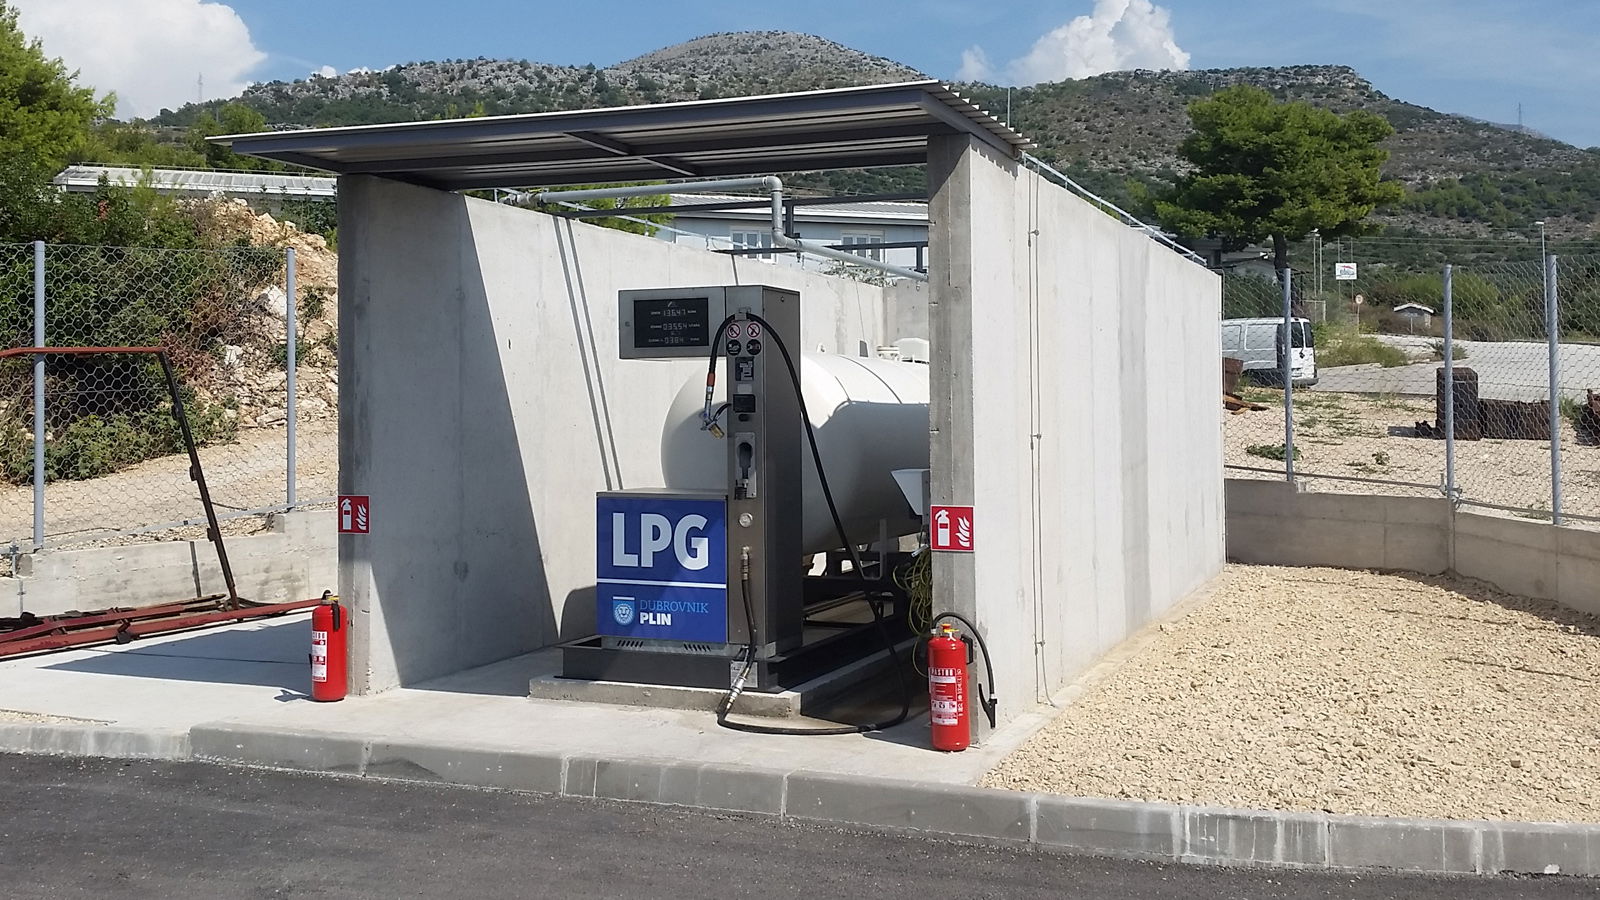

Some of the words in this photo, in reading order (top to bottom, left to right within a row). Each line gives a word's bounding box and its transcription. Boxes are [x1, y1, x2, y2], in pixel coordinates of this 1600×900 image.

[612, 512, 709, 571] LPG
[640, 599, 709, 613] DUBROVNIK
[639, 612, 672, 626] PLIN
